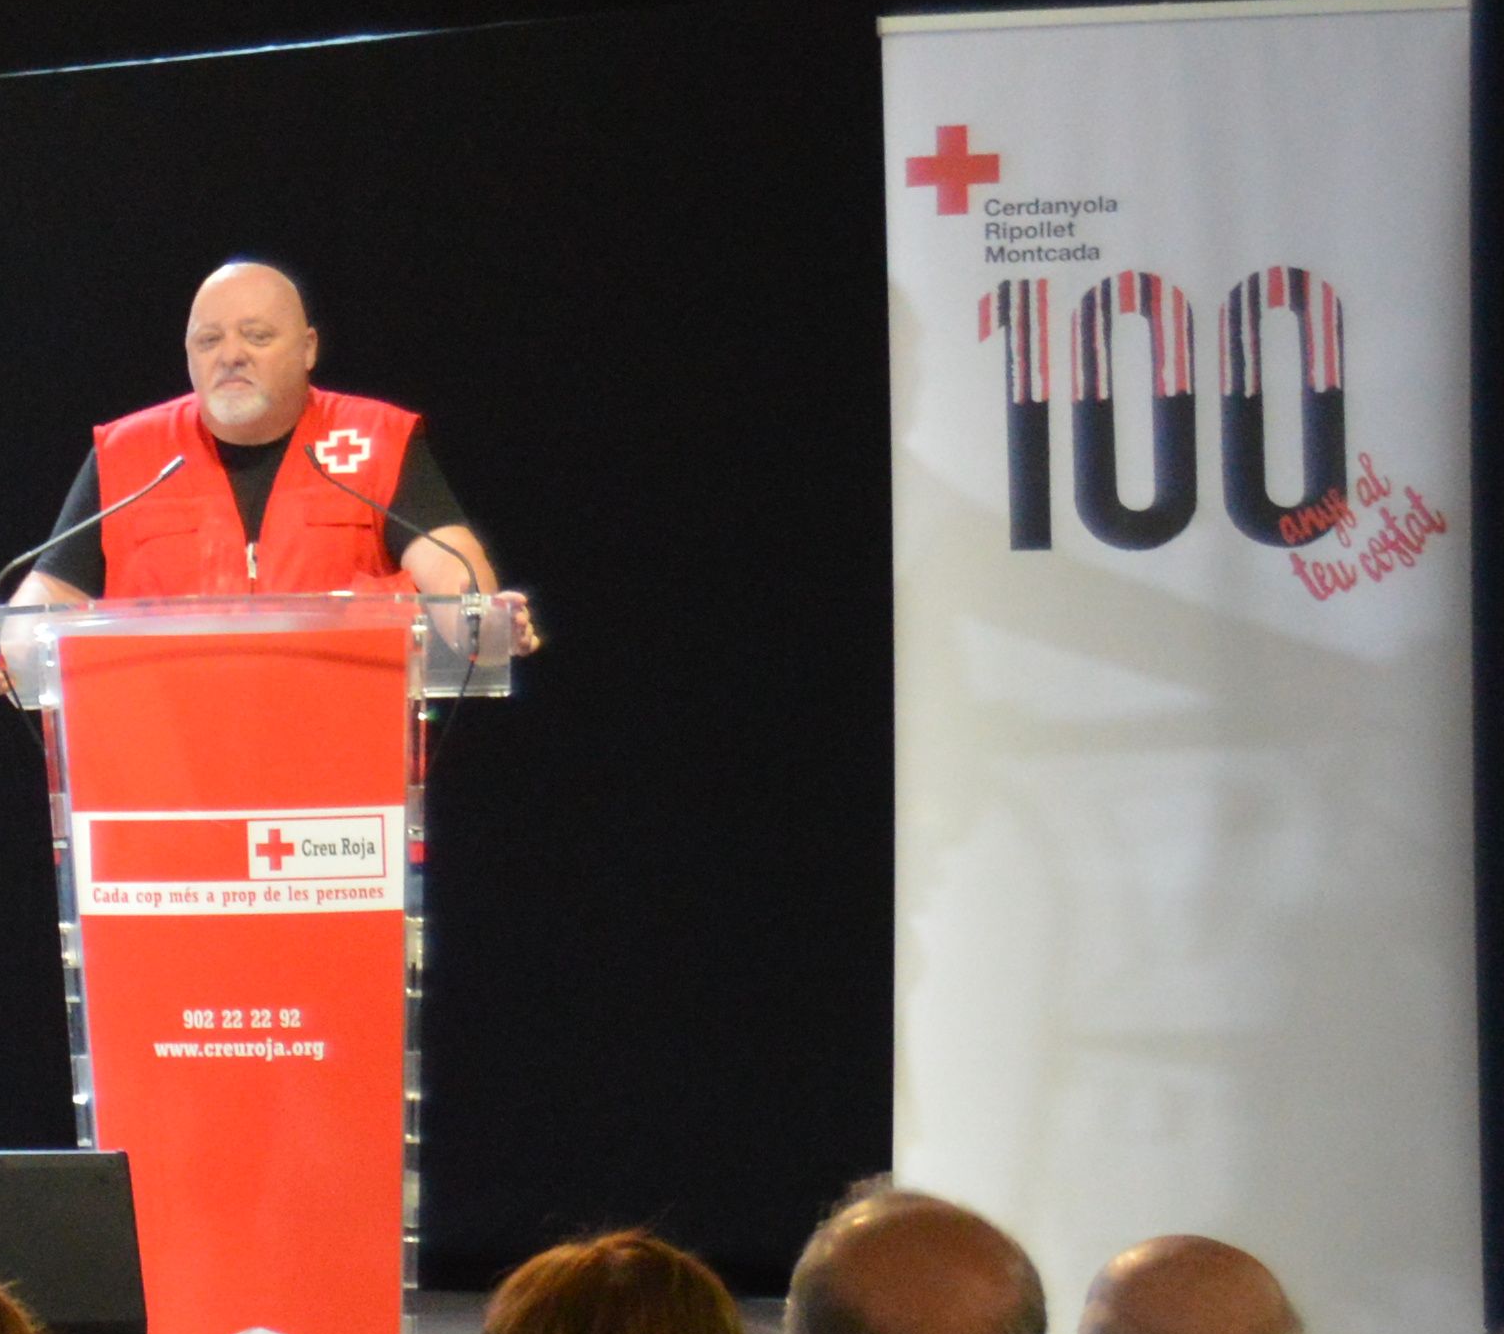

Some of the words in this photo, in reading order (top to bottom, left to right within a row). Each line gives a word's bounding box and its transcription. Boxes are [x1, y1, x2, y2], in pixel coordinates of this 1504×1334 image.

[984, 196, 1119, 218] Cerdanyola
[985, 221, 1076, 243] Ripollet
[985, 244, 1101, 264] Montcada
[978, 266, 1348, 551] 100
[1279, 487, 1357, 548] anys
[1357, 452, 1392, 508] al
[1289, 552, 1357, 601] teu
[1358, 486, 1447, 583] costat
[301, 838, 337, 857] Creu
[341, 837, 376, 860] Roja
[93, 887, 129, 904] Cada
[136, 891, 162, 908] cop
[169, 887, 199, 903] més
[206, 892, 215, 903] a
[222, 890, 257, 907] prop
[263, 886, 281, 902] de
[288, 885, 309, 901] les
[316, 886, 385, 905] persones
[182, 1009, 215, 1029] 902
[221, 1009, 243, 1029] 22
[250, 1009, 272, 1029] 22
[279, 1008, 301, 1028] 92
[153, 1037, 325, 1062] www.creuroja.org
